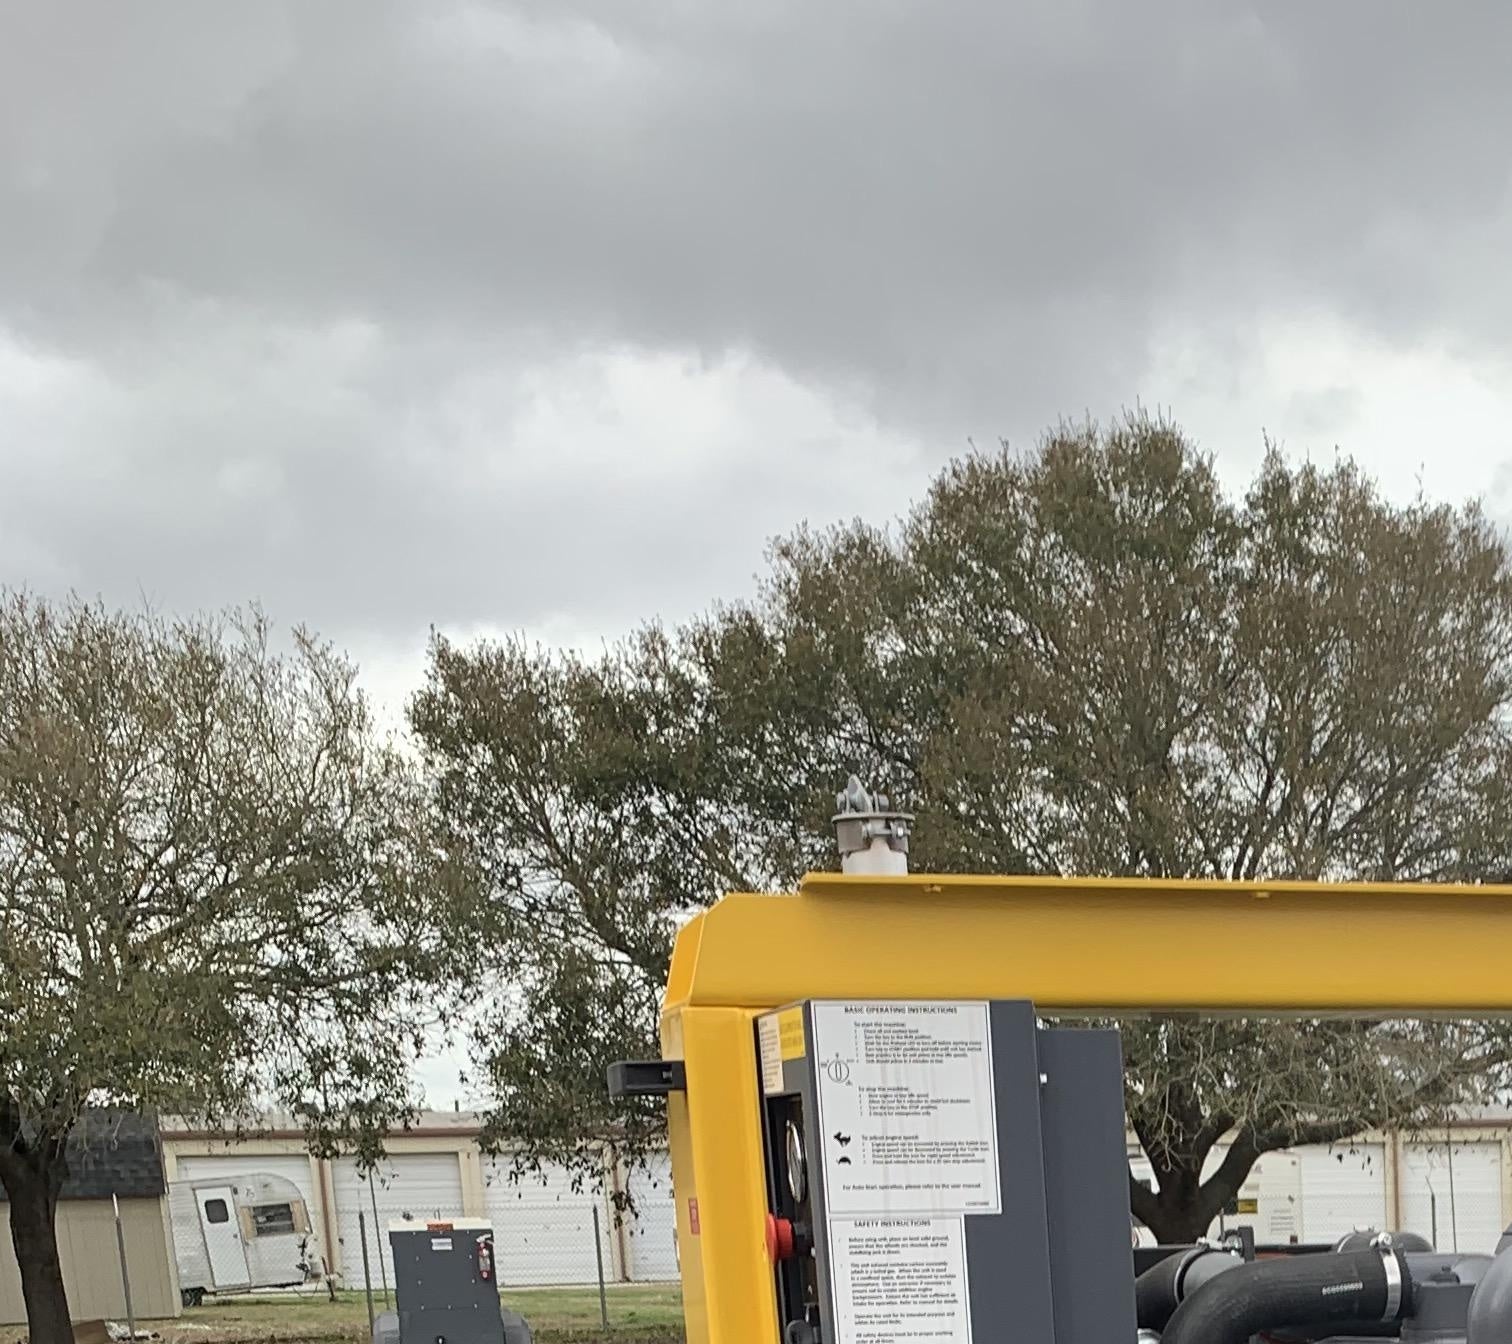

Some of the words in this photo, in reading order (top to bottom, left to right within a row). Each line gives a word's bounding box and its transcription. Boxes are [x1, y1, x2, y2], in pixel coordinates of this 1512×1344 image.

[907, 1006, 957, 1014] INSTRUCTIONS
[854, 1220, 879, 1228] SAFETY
[881, 1219, 931, 1228] INSTRUCTIONS
